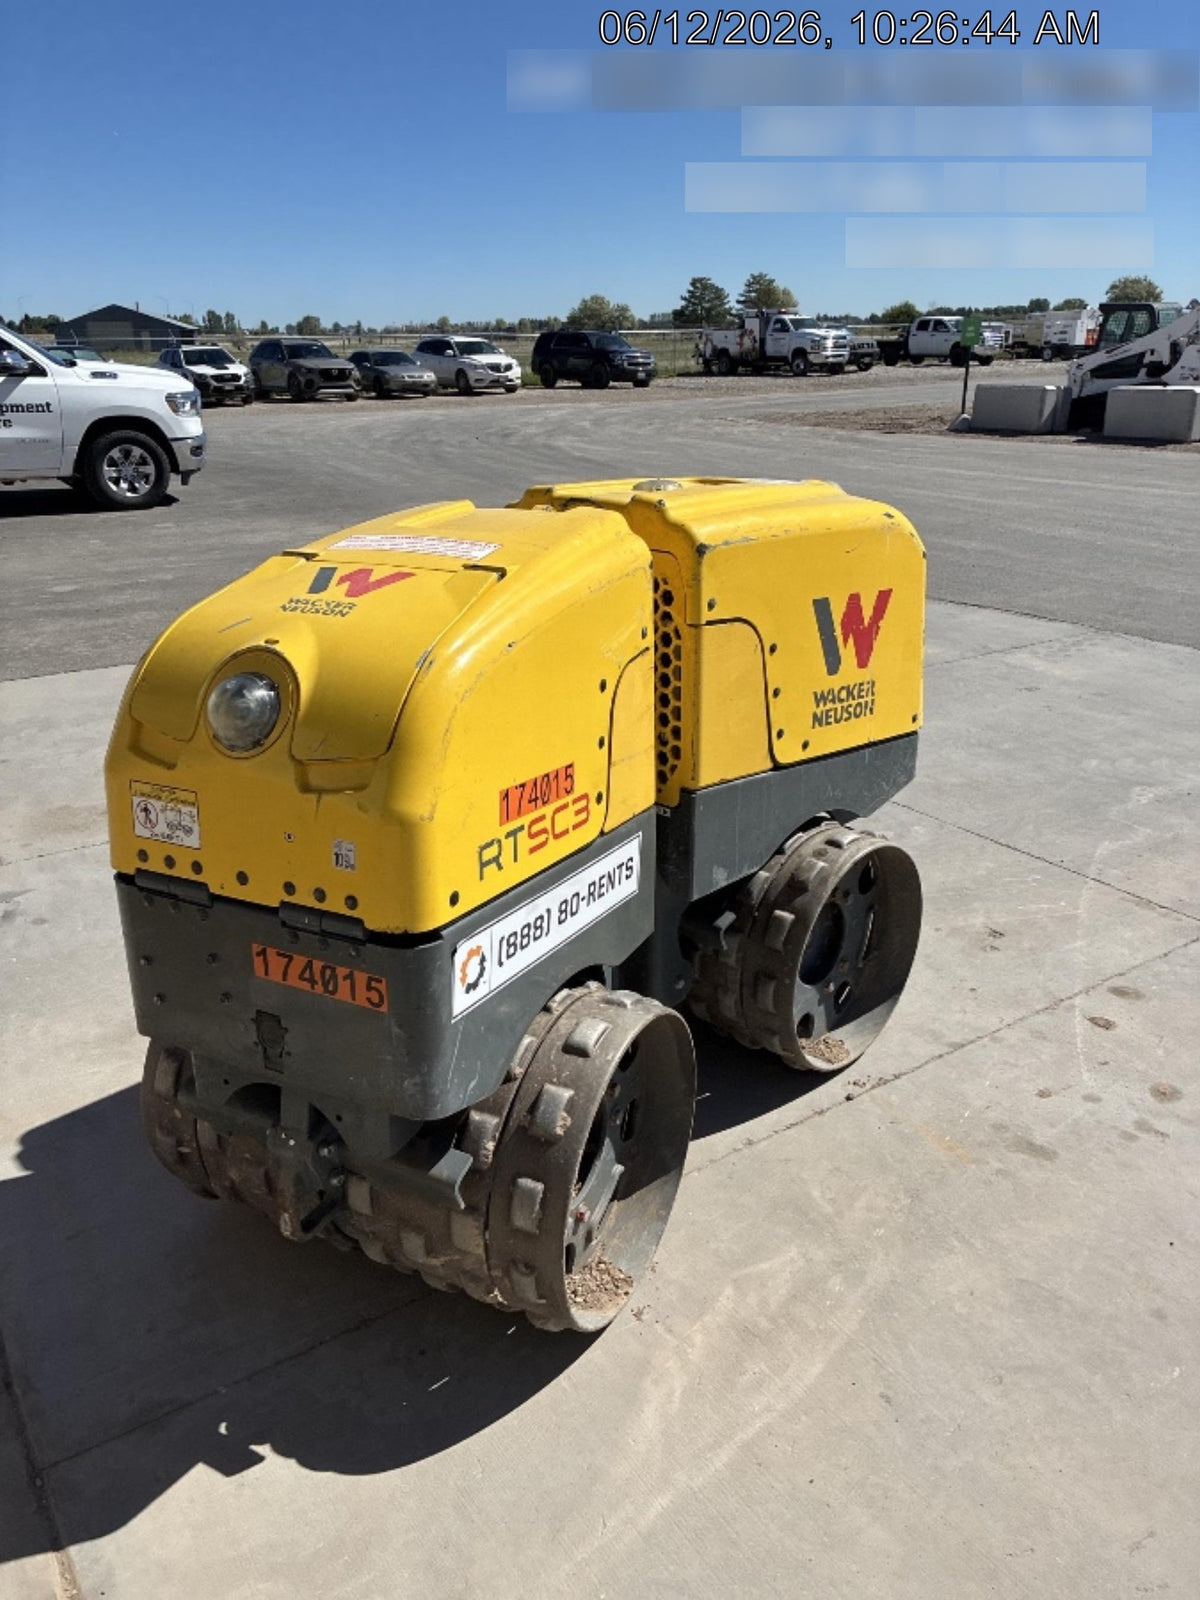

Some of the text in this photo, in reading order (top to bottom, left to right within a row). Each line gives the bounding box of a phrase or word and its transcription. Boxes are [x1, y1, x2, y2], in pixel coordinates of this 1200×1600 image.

[812, 699, 874, 729] NEUSON
[813, 680, 875, 708] WACKER
[502, 764, 575, 821] 174015
[478, 793, 591, 881] RTSC3
[498, 857, 634, 967] (888) 80-RENTS
[255, 947, 385, 1008] 174015
